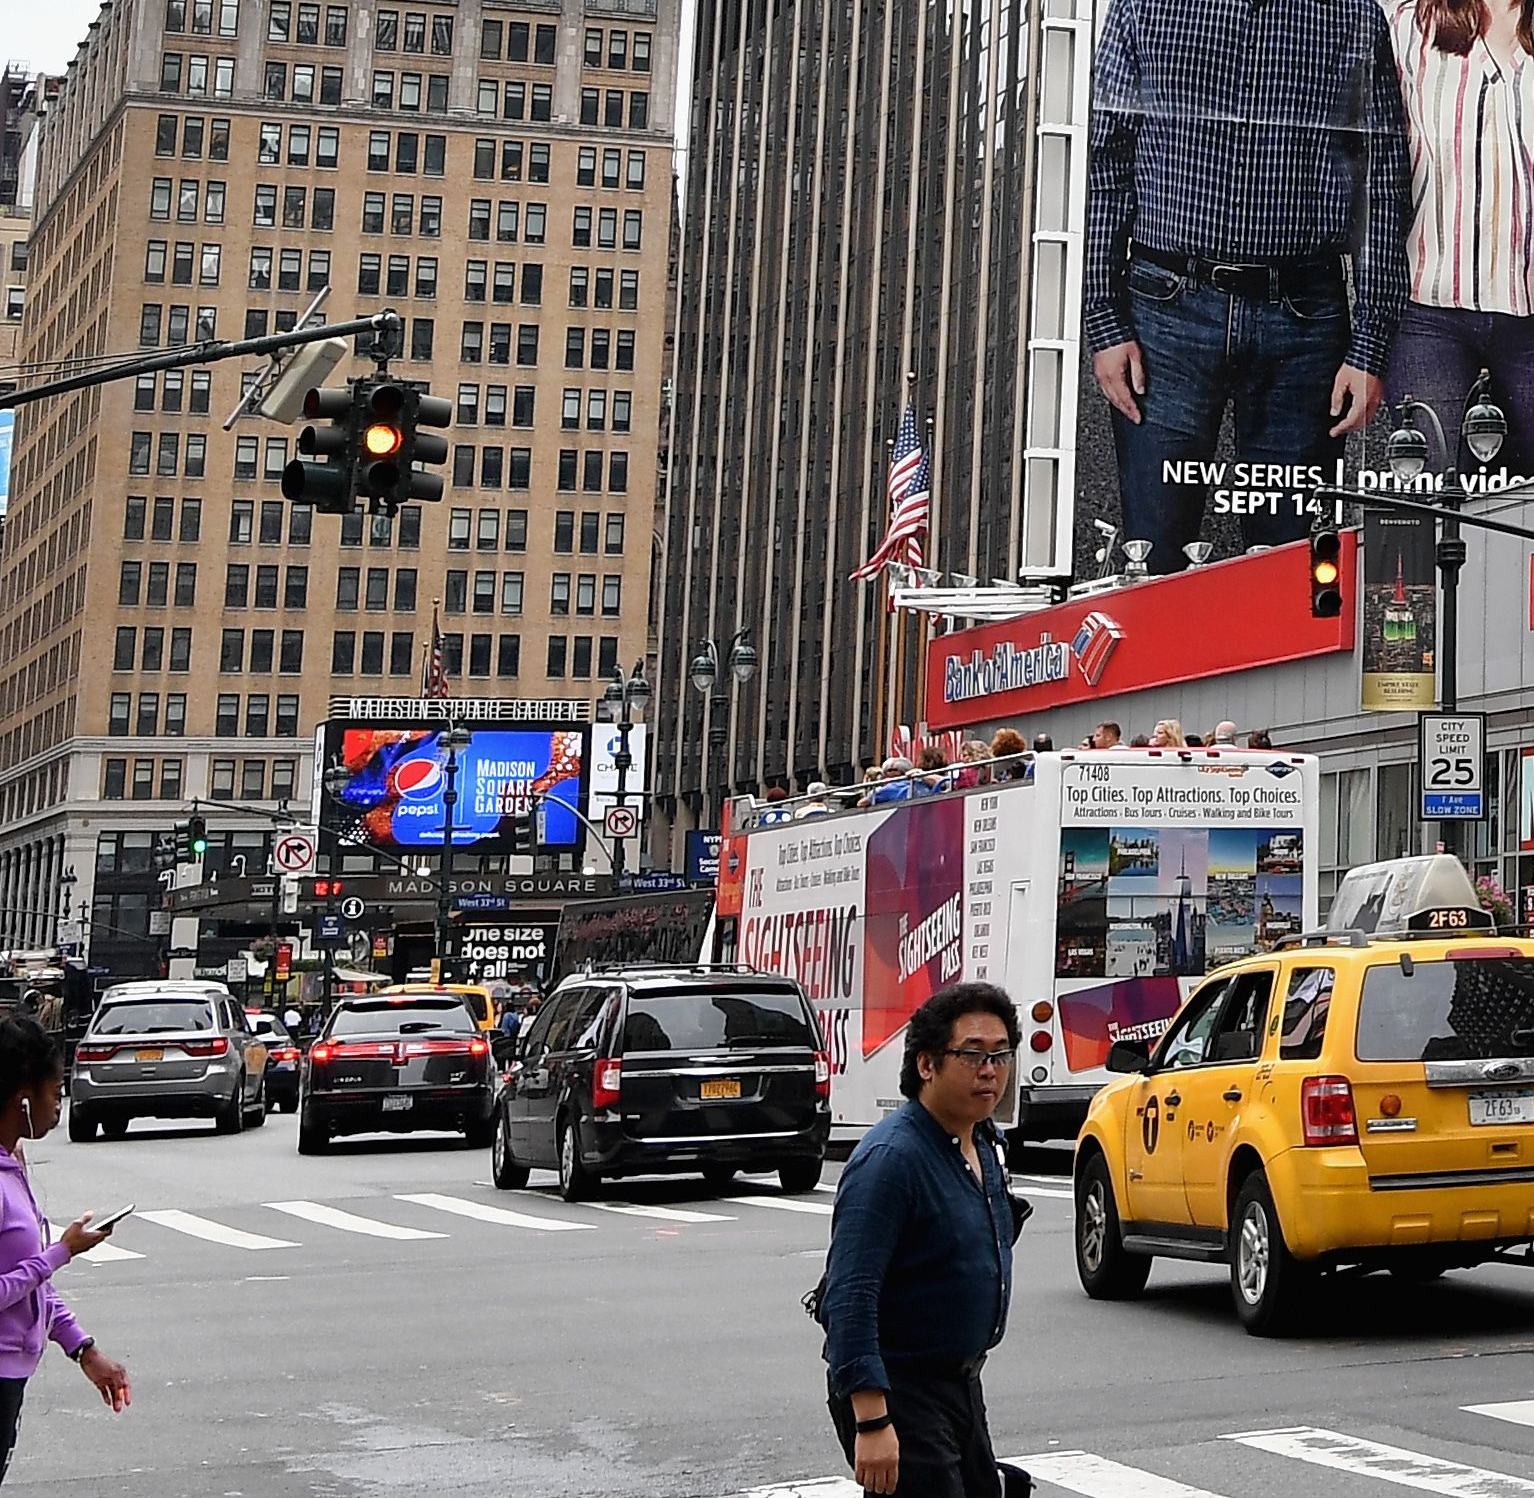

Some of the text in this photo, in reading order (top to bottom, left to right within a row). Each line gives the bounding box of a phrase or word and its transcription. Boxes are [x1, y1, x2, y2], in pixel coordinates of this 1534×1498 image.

[1162, 459, 1323, 490] NEW SERIES
[1214, 489, 1323, 516] SEPT 14
[945, 632, 1070, 703] Bank of America
[349, 699, 428, 721] MADISON
[512, 699, 578, 722] GARDEN
[1440, 722, 1465, 731] CITY
[1436, 733, 1470, 743] SPEED
[1439, 745, 1466, 755] LIMIT
[477, 760, 535, 778] MADISON
[596, 763, 638, 773] CHAE
[1079, 765, 1110, 782] 71408
[1430, 758, 1474, 786] 25
[476, 777, 535, 796] SQUARE
[1066, 786, 1301, 805] Top Cities. Top Attractions. Top Choices.
[397, 803, 439, 819] pepsi
[475, 795, 534, 814] GARDEN
[1426, 805, 1479, 815] SLOW ZONE
[1074, 807, 1294, 820] Attractions Bus Tours Cruises Walking and Bike Tours
[389, 879, 597, 894] MADSON SQUARE
[1429, 909, 1468, 928] 2F63
[503, 927, 544, 941] size
[460, 942, 546, 960] does not
[483, 961, 507, 978] all
